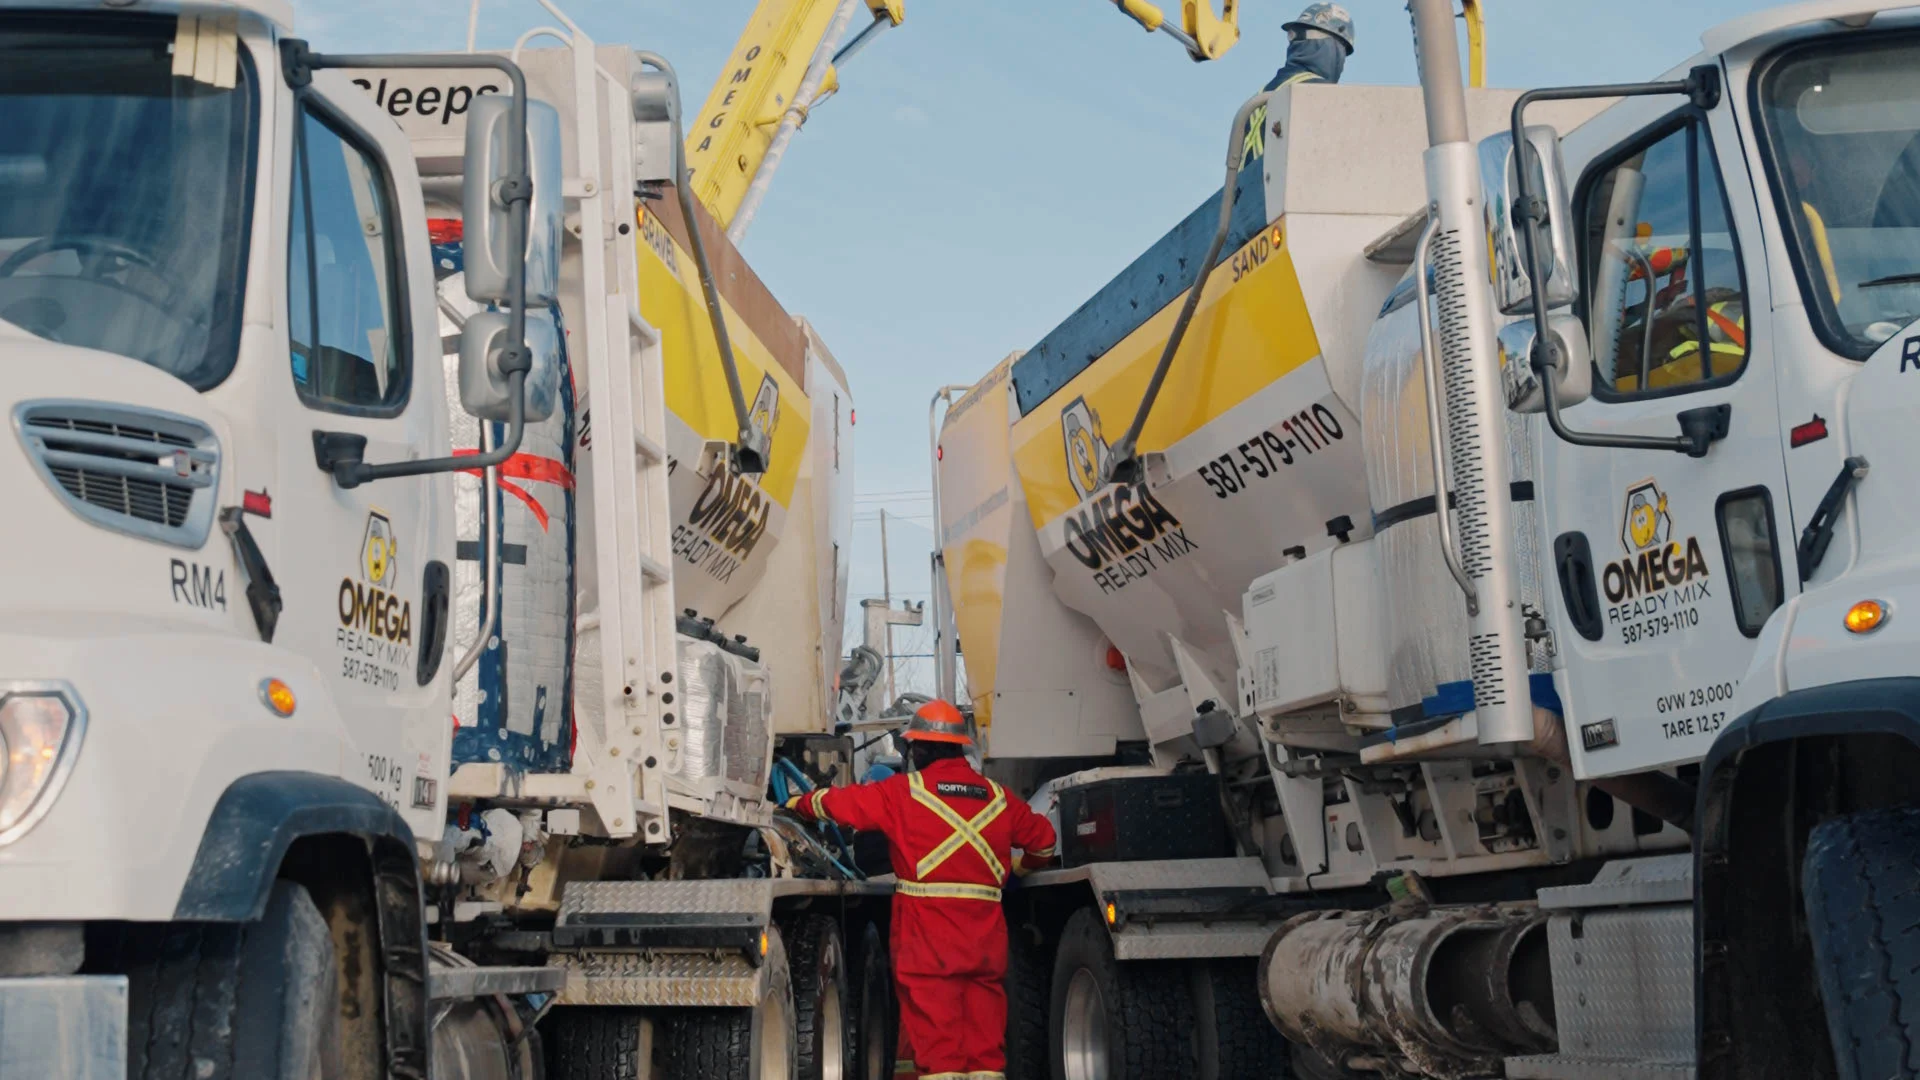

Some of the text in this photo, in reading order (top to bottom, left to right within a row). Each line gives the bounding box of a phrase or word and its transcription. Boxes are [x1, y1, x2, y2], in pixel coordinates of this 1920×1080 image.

[351, 78, 499, 125] leep
[696, 45, 761, 152] OMEGA
[1232, 235, 1269, 283] SAND
[1197, 403, 1343, 499] 587-579-1110
[688, 459, 771, 562] OMEGA
[1063, 482, 1181, 570] OMEGA
[671, 525, 742, 585] READY MIX
[1093, 527, 1199, 595] READY MIX
[1603, 536, 1709, 604] OMEGA
[169, 557, 226, 612] RM4
[338, 576, 411, 647] OMEGA
[1608, 579, 1711, 624] READY MIX
[336, 627, 411, 670] READY MIX
[1622, 607, 1699, 644] 587-579-1110
[342, 656, 399, 692] 587-579-1110
[1657, 682, 1733, 713] GVW 29,000
[1662, 718, 1695, 739] TARE
